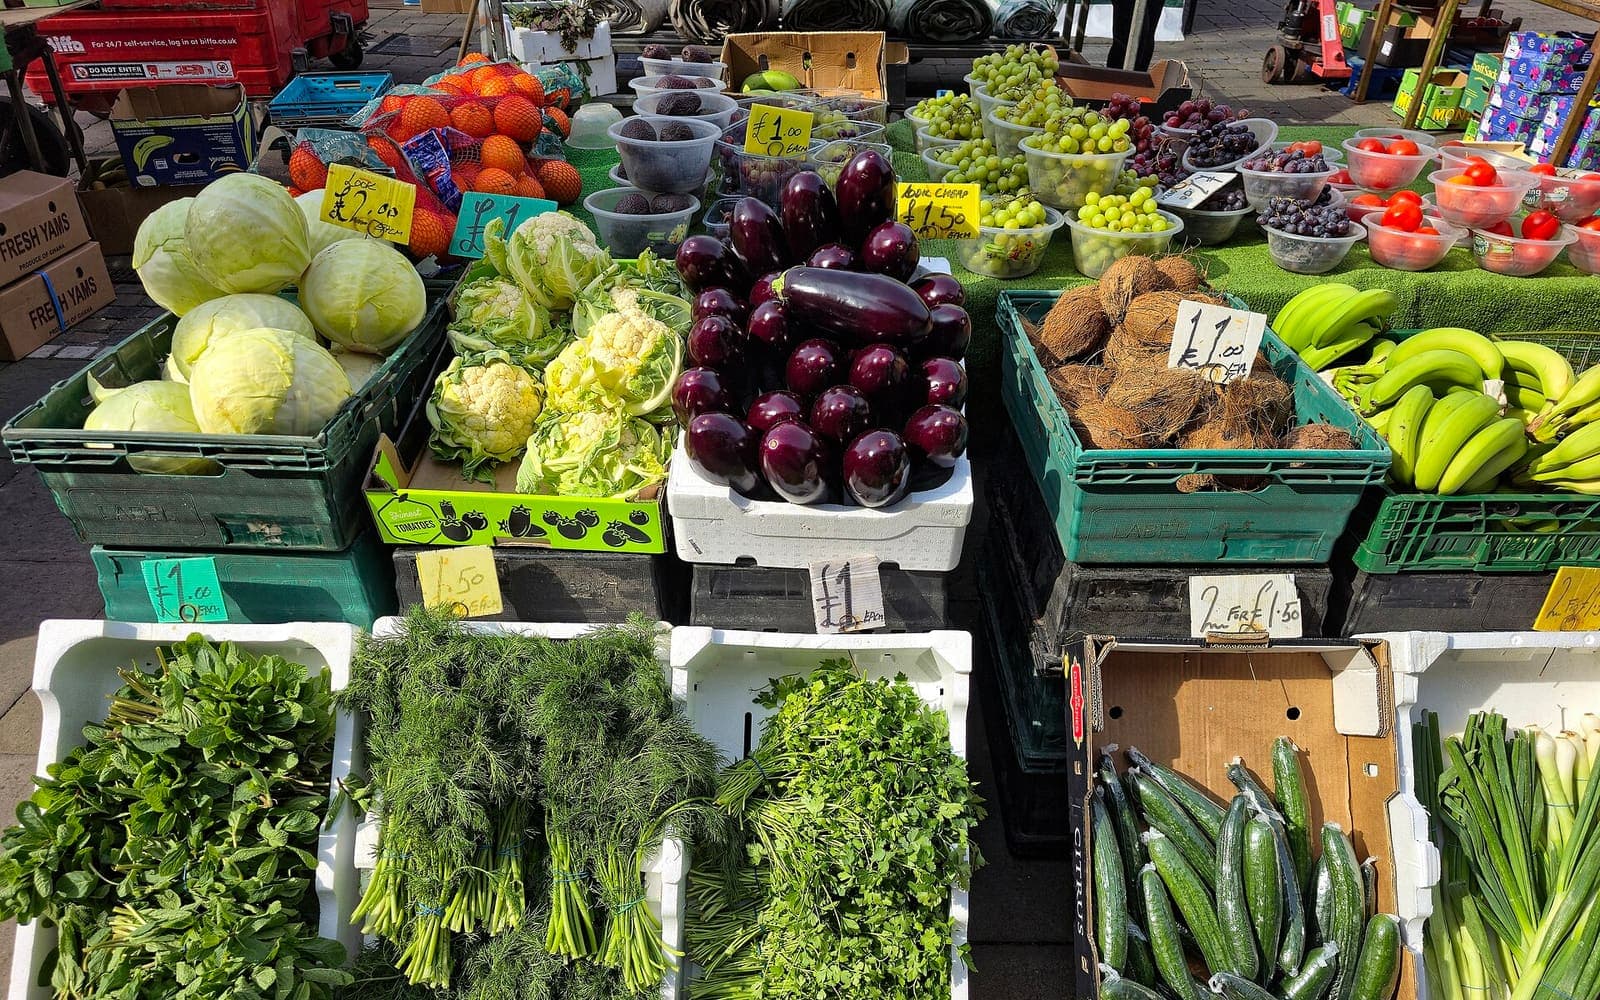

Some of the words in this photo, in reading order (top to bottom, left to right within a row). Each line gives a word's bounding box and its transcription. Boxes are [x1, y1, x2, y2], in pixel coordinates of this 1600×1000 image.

[105, 40, 122, 48] 24/7
[124, 38, 168, 47] self-service,
[168, 38, 181, 47] log
[200, 37, 237, 46] biffa.co.uk
[118, 65, 142, 73] ENTER
[1, 225, 41, 263] FRESH
[39, 212, 70, 242] YAMS
[19, 255, 43, 271] PRODUCE
[42, 251, 49, 260] OF
[29, 293, 70, 330] FREH
[68, 276, 98, 308] YAMS
[394, 519, 436, 533] TOMATOES
[1111, 520, 1191, 539] LABEL
[816, 561, 853, 628] £1
[1073, 827, 1084, 937] CITRUS
